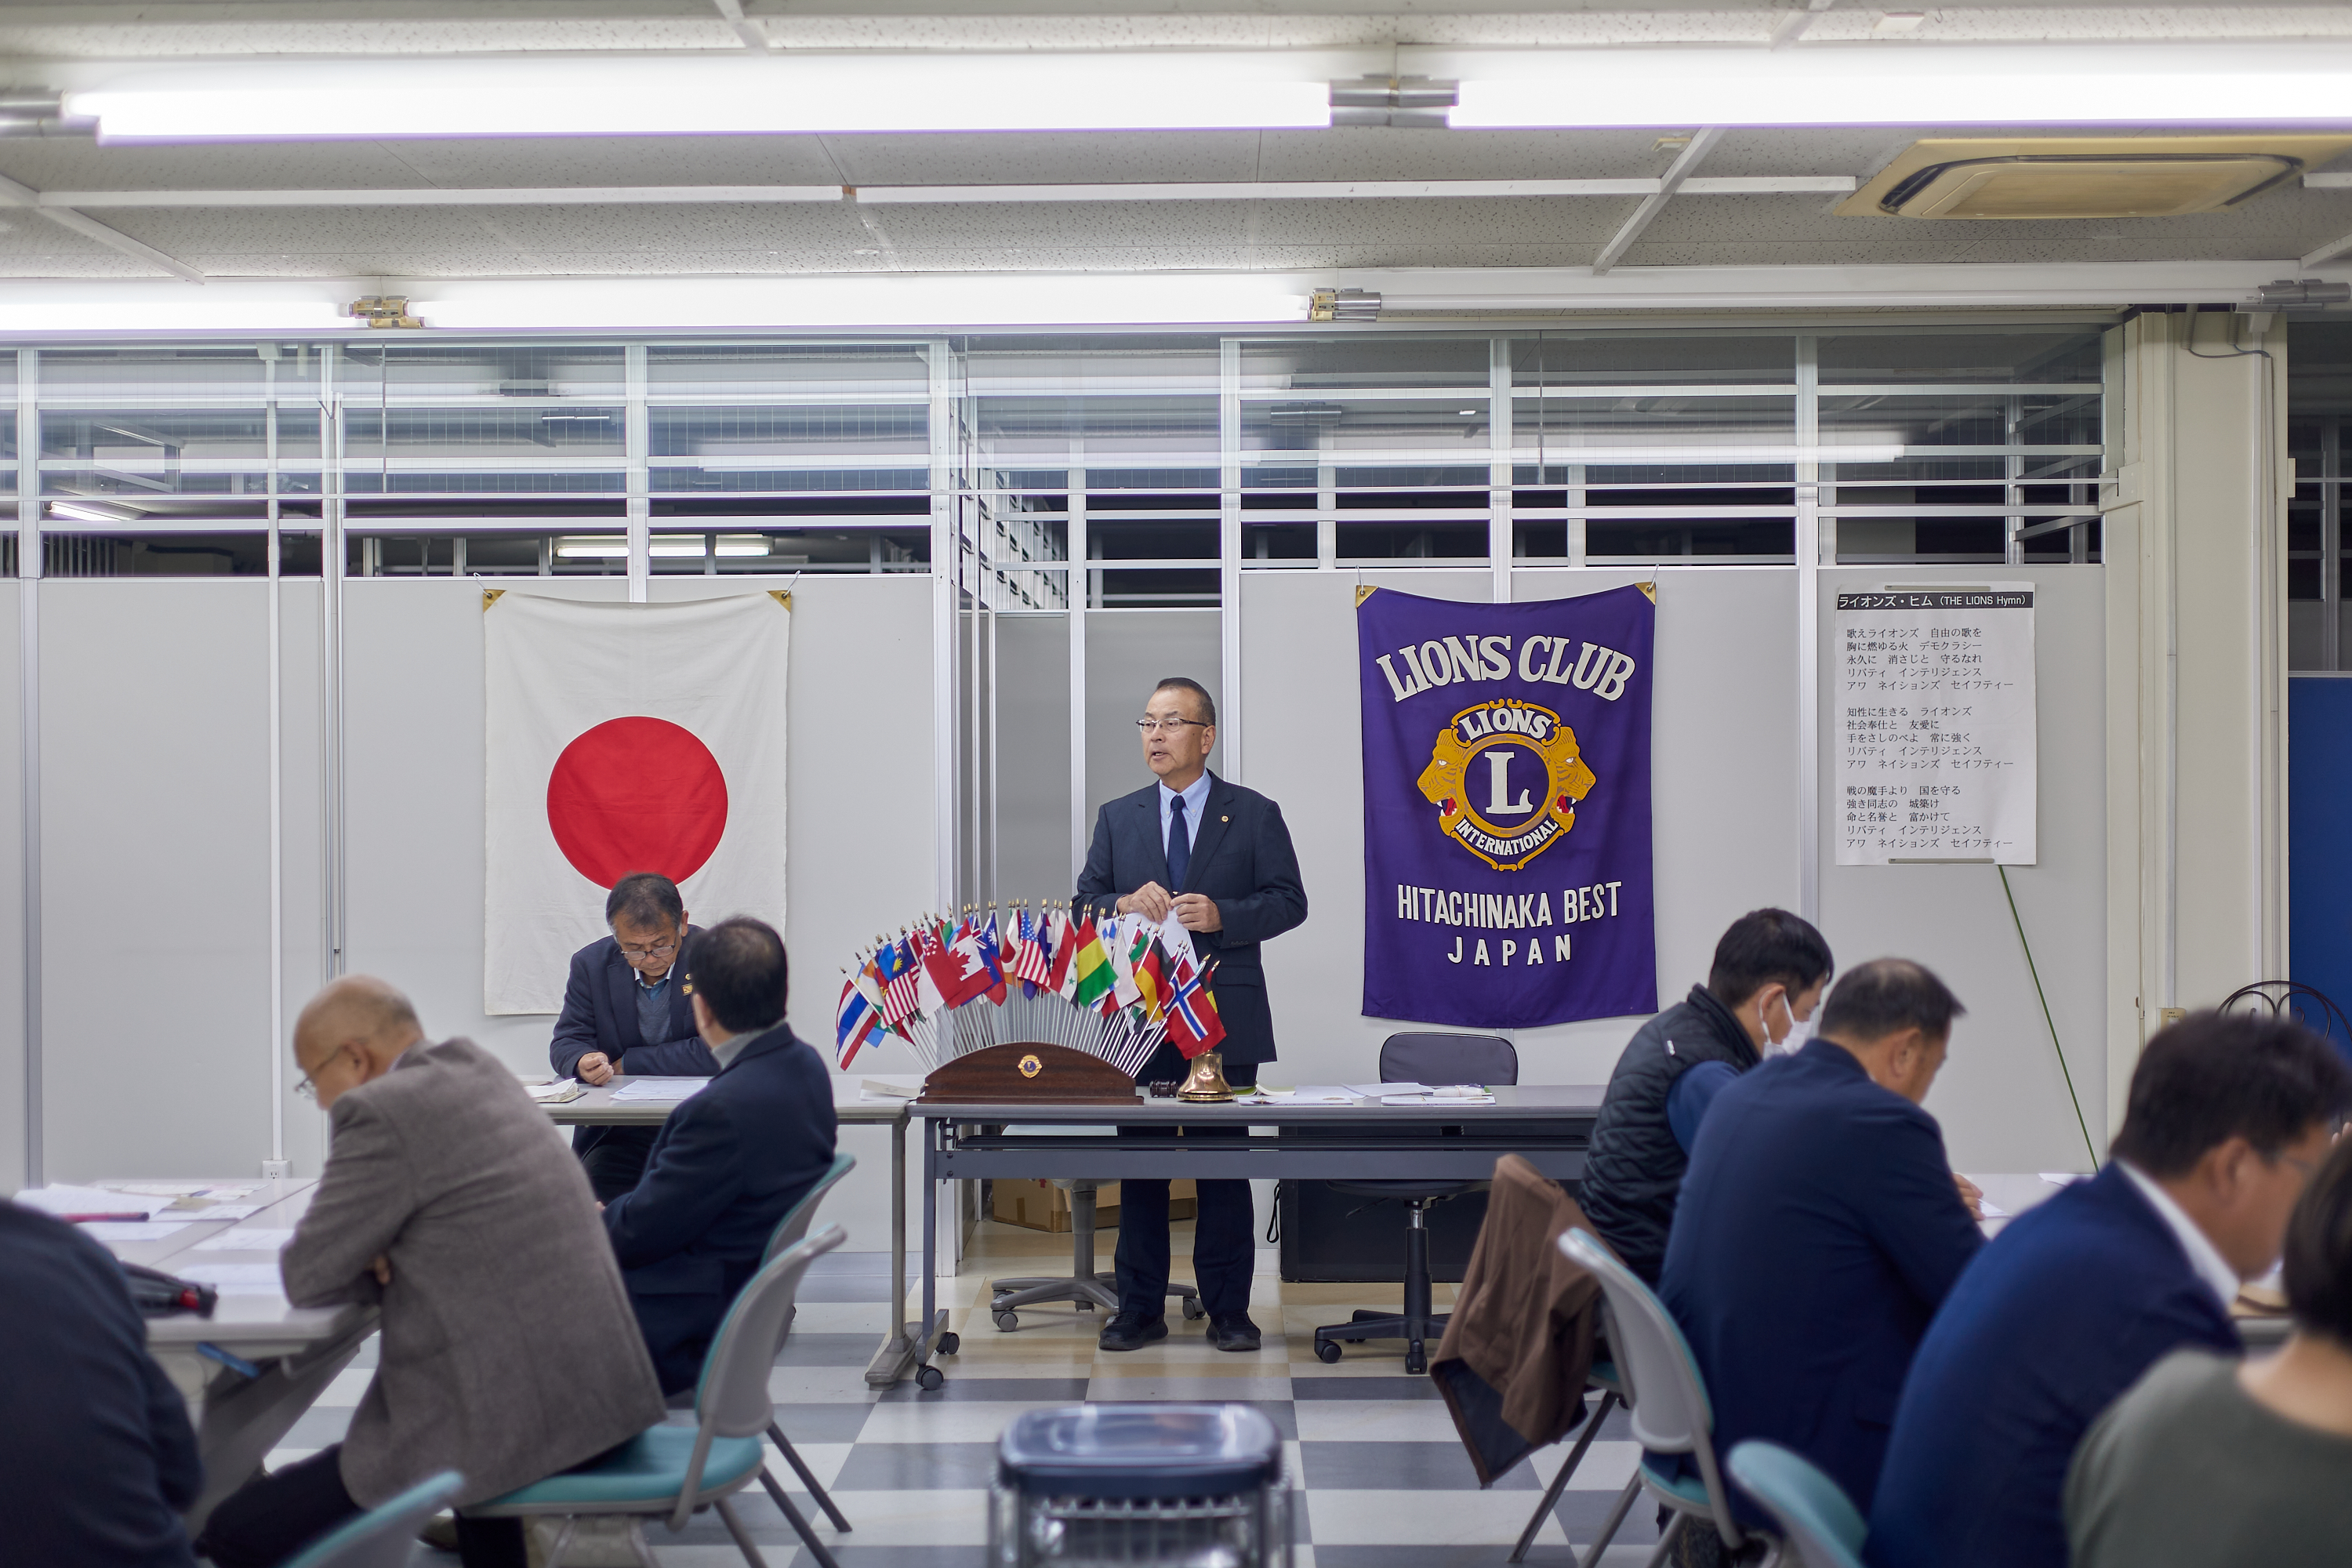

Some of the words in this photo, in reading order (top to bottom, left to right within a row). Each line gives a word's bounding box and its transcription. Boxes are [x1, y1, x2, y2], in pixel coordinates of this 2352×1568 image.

[1966, 596, 1993, 605] LIONS
[1847, 628, 1918, 638] 歌えライオンズ
[1932, 628, 1981, 637] 自由の歌を
[1920, 641, 1981, 651] デモクラシー
[1847, 655, 1876, 665] 永久に
[1889, 655, 1929, 664] 消さじと
[1940, 654, 1982, 664] 守るなれ
[1377, 636, 1512, 702] LIONS
[1519, 636, 1635, 701] CLUB
[1849, 669, 1885, 677] リバティ
[1899, 668, 1981, 677] インテリジェンス
[1878, 681, 1940, 690] ネイションズ
[1951, 681, 2013, 689] セイフティー
[1847, 707, 1907, 717] 知性に生きる
[1921, 706, 1972, 716] ライオンズ
[1460, 708, 1552, 741] LIONS
[1847, 720, 1896, 730] 社会奉仕と
[1909, 720, 1939, 730] 友愛に
[1848, 733, 1918, 742] 手をさしのべよ
[1930, 733, 1969, 742] 常に強く
[1849, 746, 1885, 756] リバティ
[1899, 746, 1981, 756] インテリジェンス
[1878, 759, 1940, 769] ネイションズ
[1951, 760, 2013, 768] セイフティー
[1484, 751, 1534, 815] L
[1920, 786, 1960, 795] 国を守る
[1847, 799, 1897, 808] 強き同志の
[1847, 812, 1896, 822] 命と名誉と
[1909, 812, 1950, 822] 富かけて
[1849, 826, 1885, 835] リバティ
[1899, 826, 1981, 835] インテリジェンス
[1454, 819, 1559, 856] INTERNATIONAL
[1847, 839, 1865, 848] アワ
[1878, 838, 1940, 848] ネイションズ
[1951, 839, 2012, 848] セイフティー
[1397, 884, 1552, 930] HITACHINAKA
[1563, 880, 1621, 924] BEST
[1446, 934, 1571, 967] JAPAN
